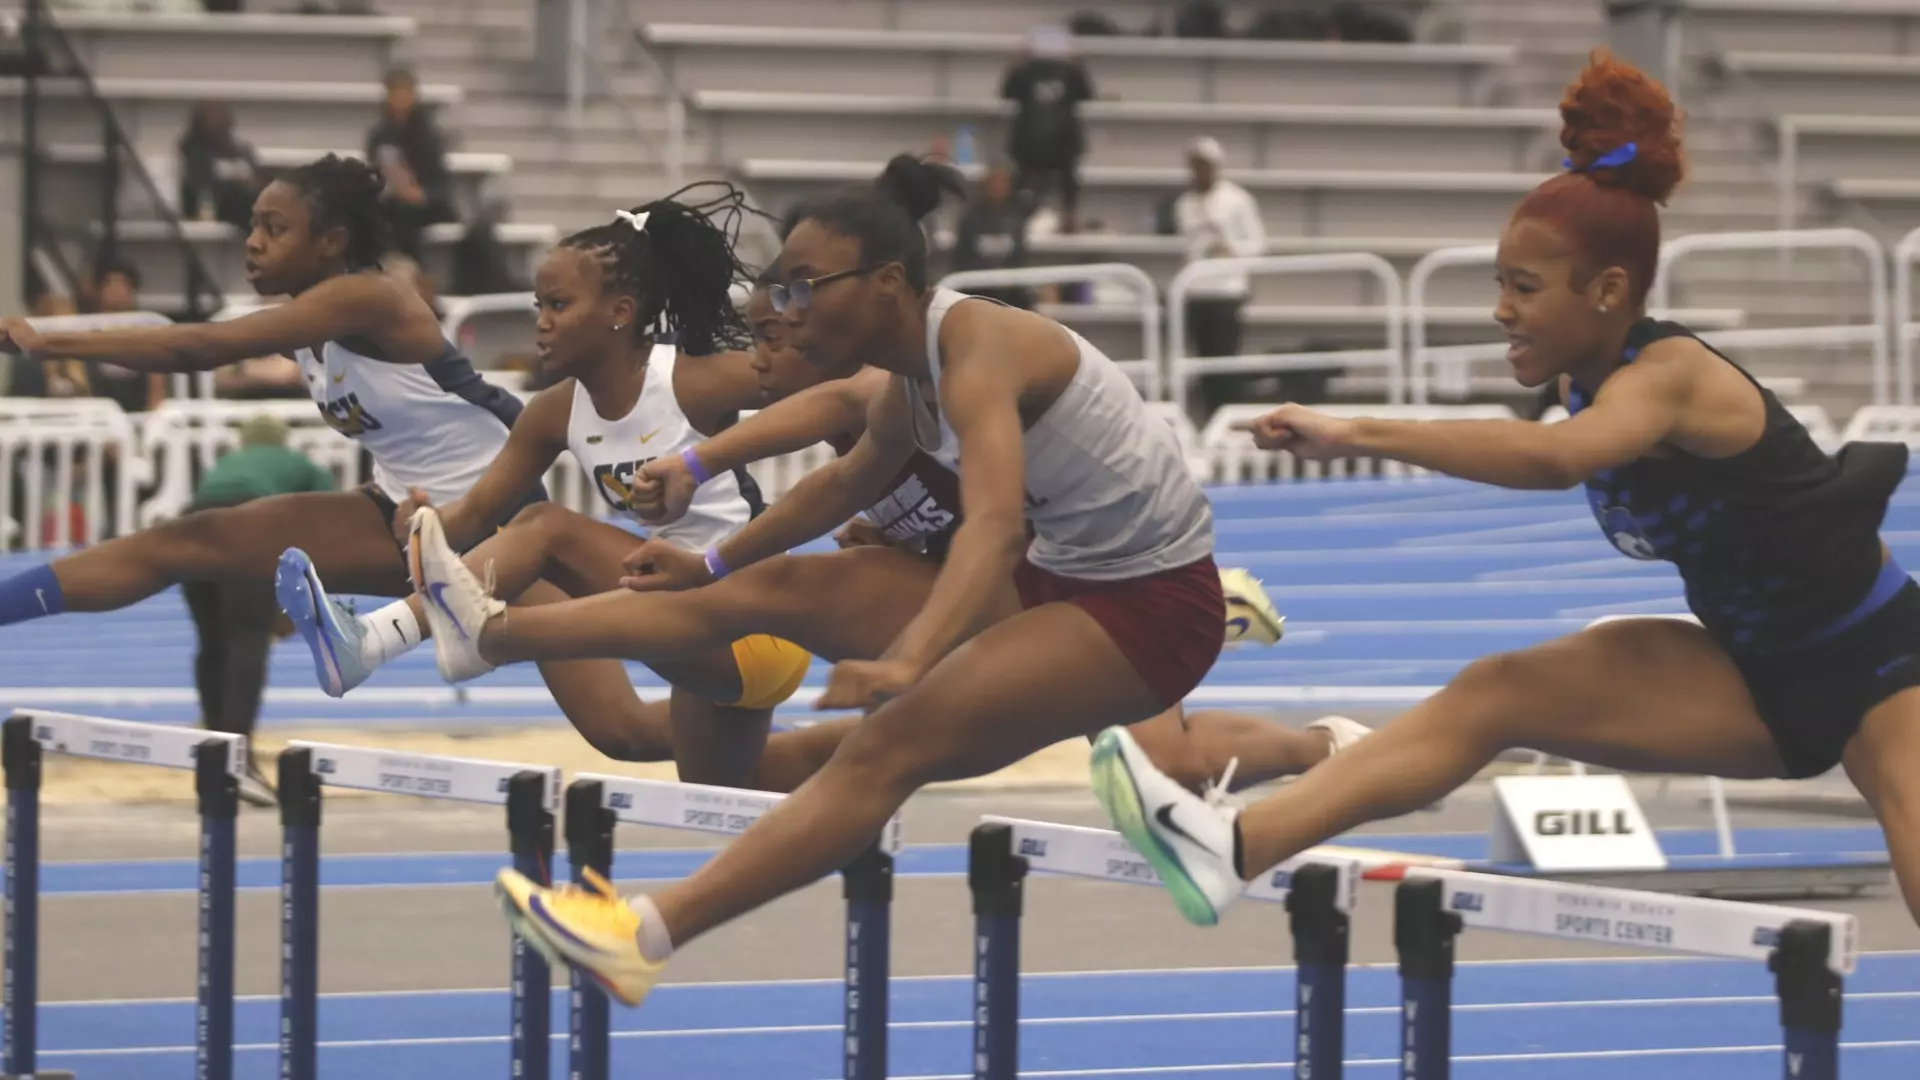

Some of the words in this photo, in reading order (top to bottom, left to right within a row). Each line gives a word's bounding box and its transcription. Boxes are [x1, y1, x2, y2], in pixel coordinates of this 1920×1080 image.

[1534, 809, 1635, 836] GILL
[1556, 913, 1610, 936] SPORTS
[1615, 919, 1673, 944] CENTER
[975, 935, 990, 1080] VIRGIN
[1404, 999, 1418, 1080] VIR
